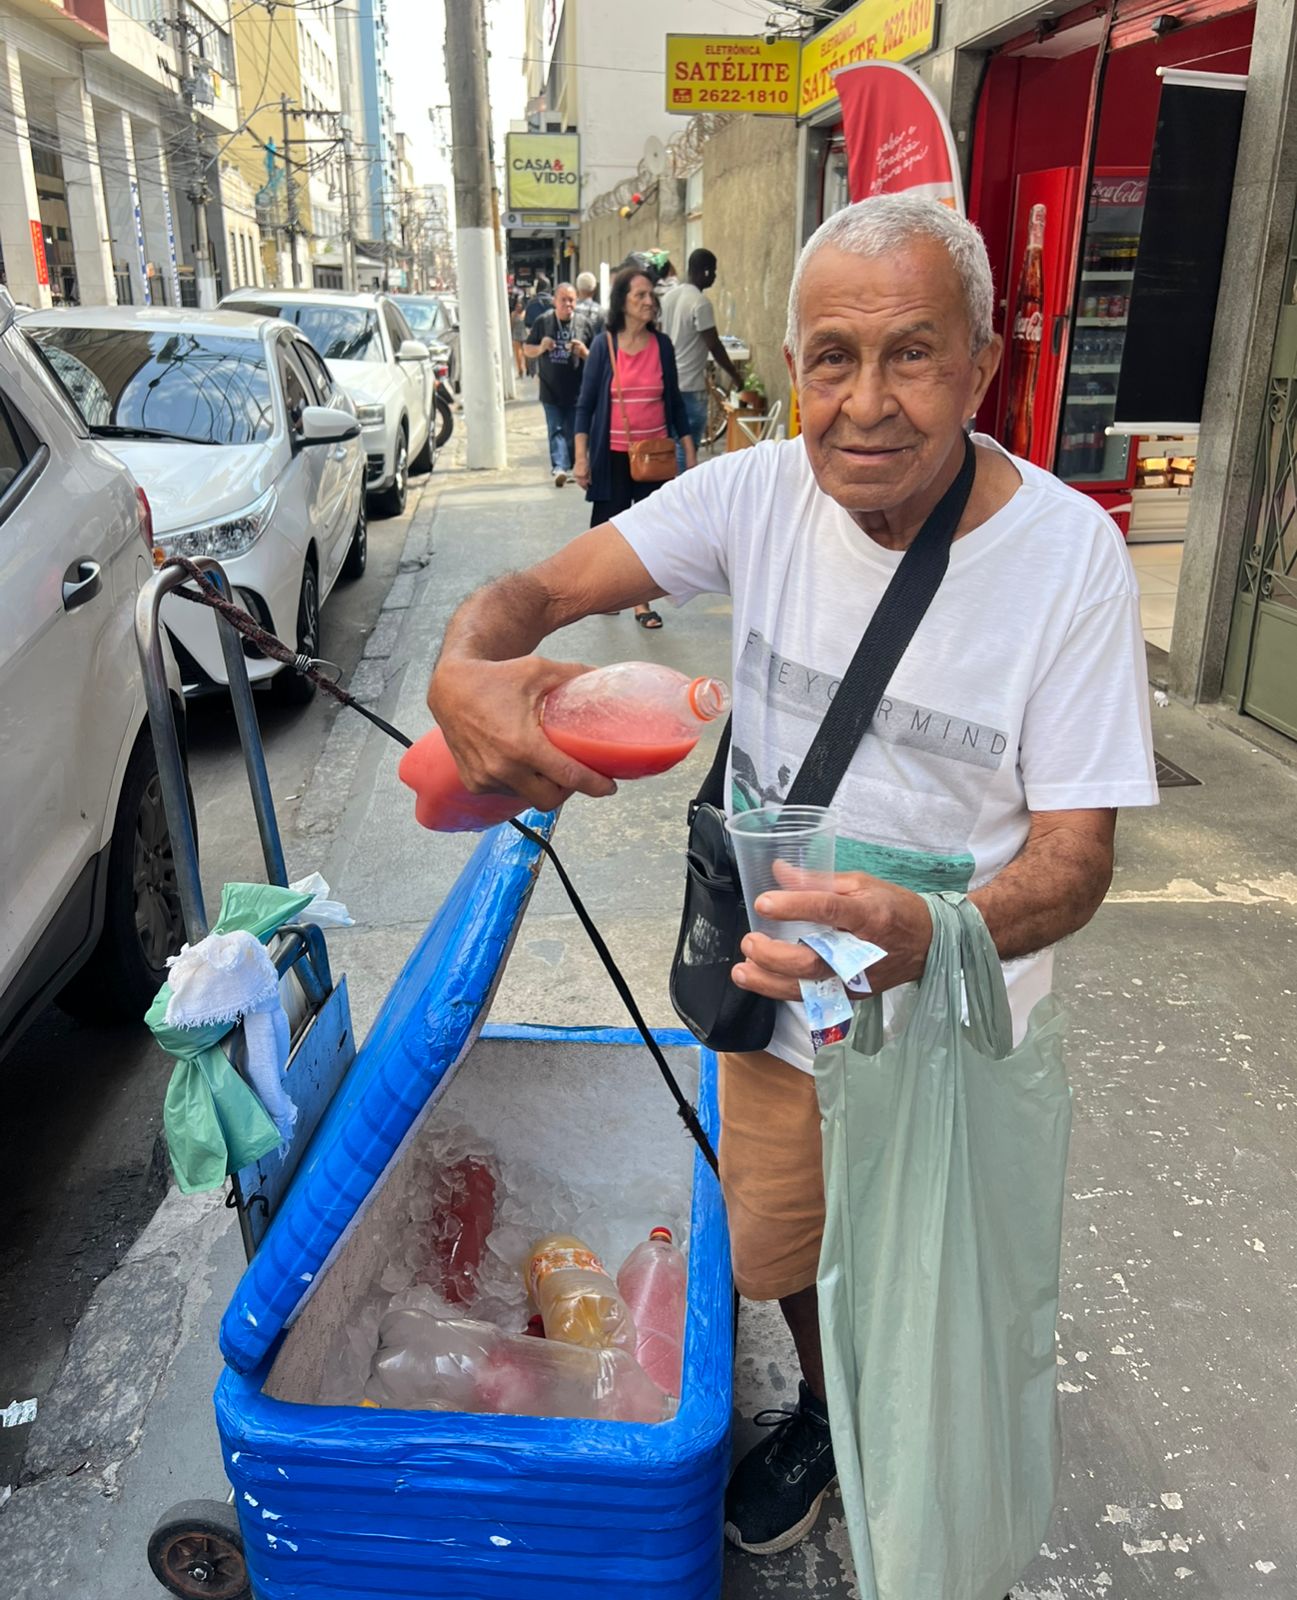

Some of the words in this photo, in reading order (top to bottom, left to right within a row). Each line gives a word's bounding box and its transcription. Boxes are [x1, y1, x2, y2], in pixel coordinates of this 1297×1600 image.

[675, 57, 790, 82] SATÉLITE
[699, 89, 788, 102] 2622-1810
[533, 172, 577, 185] VIDEO
[910, 709, 1008, 755] MIND
